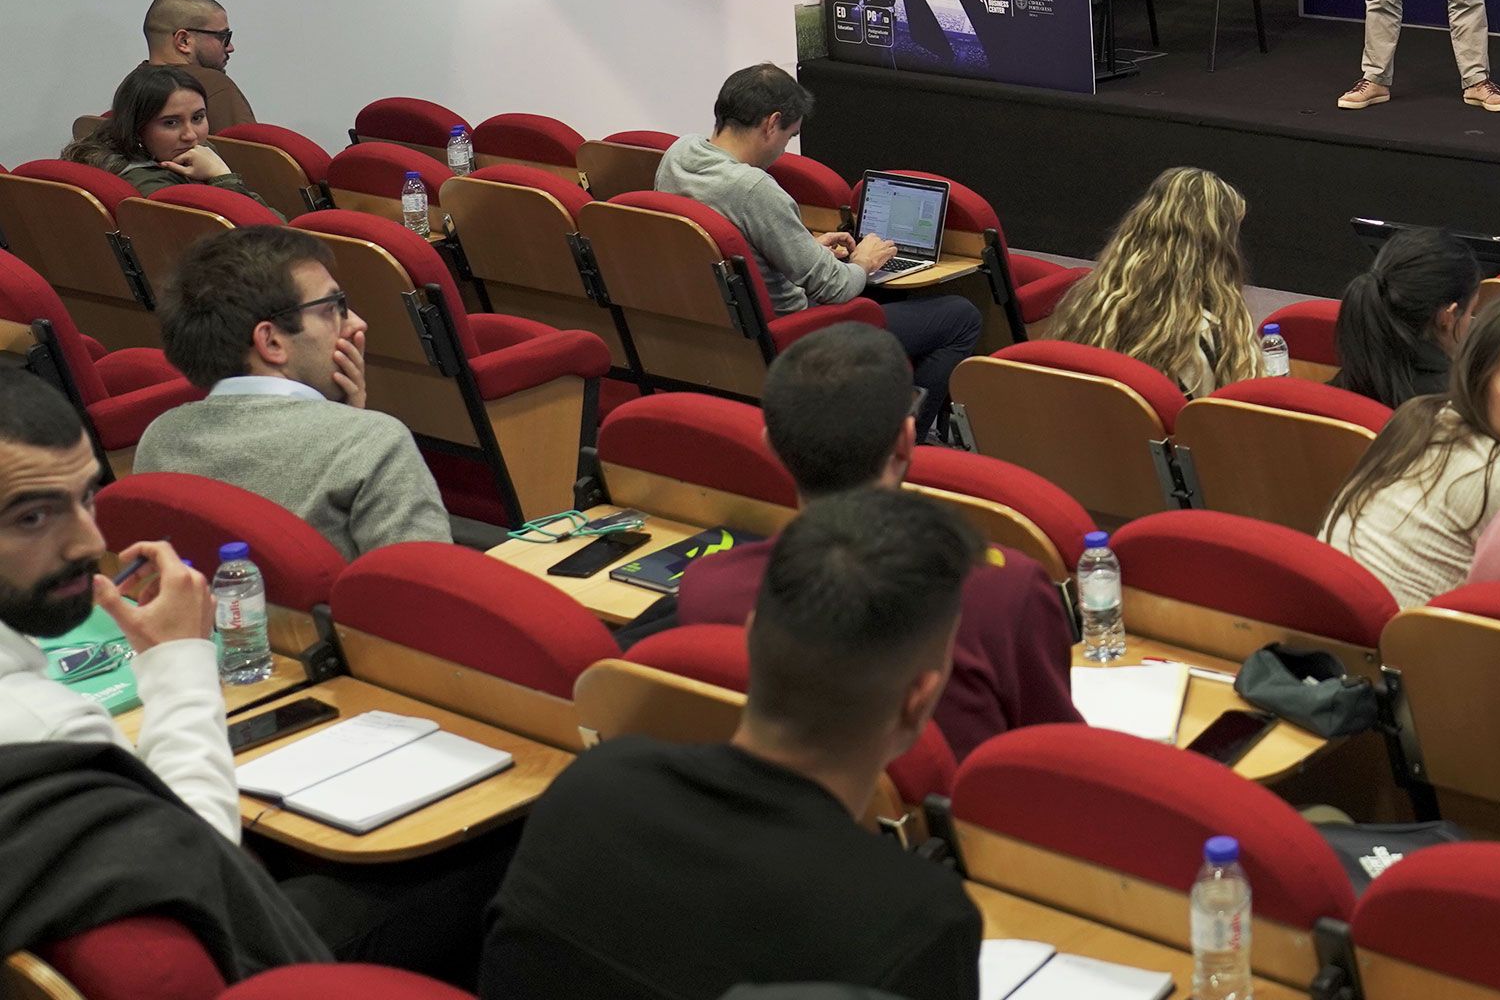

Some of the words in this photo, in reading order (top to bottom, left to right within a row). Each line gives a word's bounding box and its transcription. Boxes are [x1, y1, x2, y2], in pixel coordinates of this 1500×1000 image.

[836, 6, 846, 18] ED
[866, 10, 877, 22] PG
[229, 600, 241, 629] Vitalis
